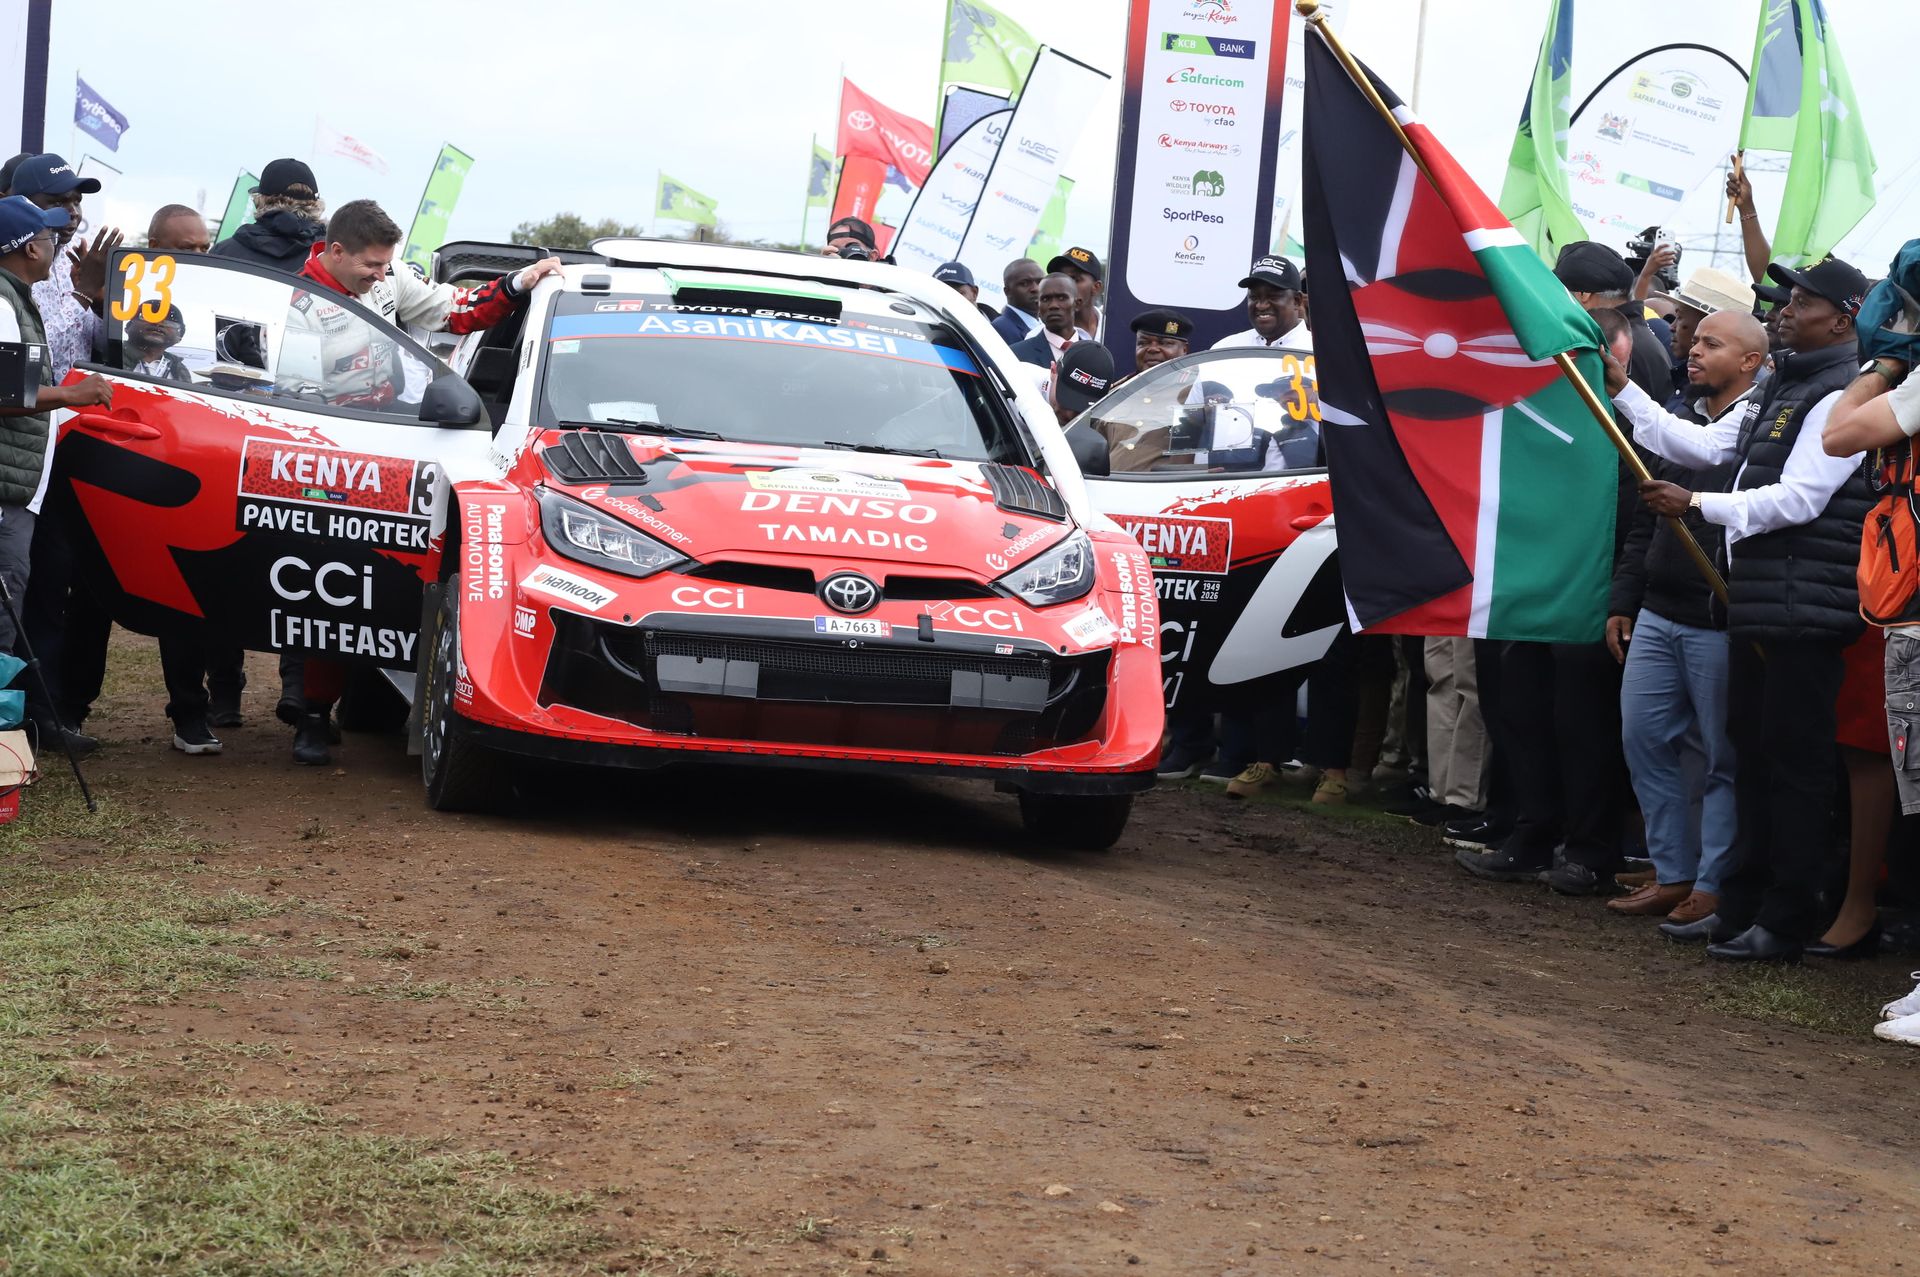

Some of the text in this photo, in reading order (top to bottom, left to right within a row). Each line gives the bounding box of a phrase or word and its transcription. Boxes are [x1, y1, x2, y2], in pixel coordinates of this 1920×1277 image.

[1207, 10, 1238, 24] Kenya
[1178, 39, 1245, 54] KCB BANK
[1180, 72, 1244, 88] Safaricom
[1189, 102, 1236, 116] TOYOTA
[1633, 92, 1656, 103] SAFARI
[1676, 104, 1698, 116] KENYA
[1214, 117, 1235, 127] cfao
[1020, 136, 1060, 161] WRC
[1173, 139, 1228, 150] Kenya Airways
[1165, 182, 1191, 190] WILDLIFE
[1163, 207, 1224, 224] SportPesa
[915, 216, 962, 242] AsahiKASE
[1174, 251, 1206, 261] KenGen
[111, 253, 176, 323] 33
[597, 301, 927, 342] GR TOYOTA GAZOO Racing
[638, 314, 899, 356] AsahiKASEI
[270, 450, 382, 493] KENYA
[603, 495, 690, 544] codebeamer
[740, 491, 938, 524] DENSO
[243, 504, 428, 549] PAVEL HORTEK
[758, 523, 928, 552] TAMADIC
[1125, 521, 1208, 556] KENYA
[466, 502, 484, 602] AUTOMOTIVE
[486, 504, 509, 600] Panasonic
[1003, 525, 1057, 558] codebeamer
[269, 555, 373, 610] CCi
[1154, 577, 1200, 601] RTEK
[1200, 591, 1219, 600] 2026
[1203, 582, 1221, 592] 1949
[671, 586, 744, 609] CCi
[1110, 551, 1137, 645] Panasonic
[1130, 552, 1155, 650] AUTOMOTIVE
[514, 610, 536, 633] OMP
[830, 620, 876, 634] A-7663
[953, 605, 1024, 632] CCi
[270, 608, 417, 661] [FIT-EASY
[1159, 620, 1199, 663] Ci
